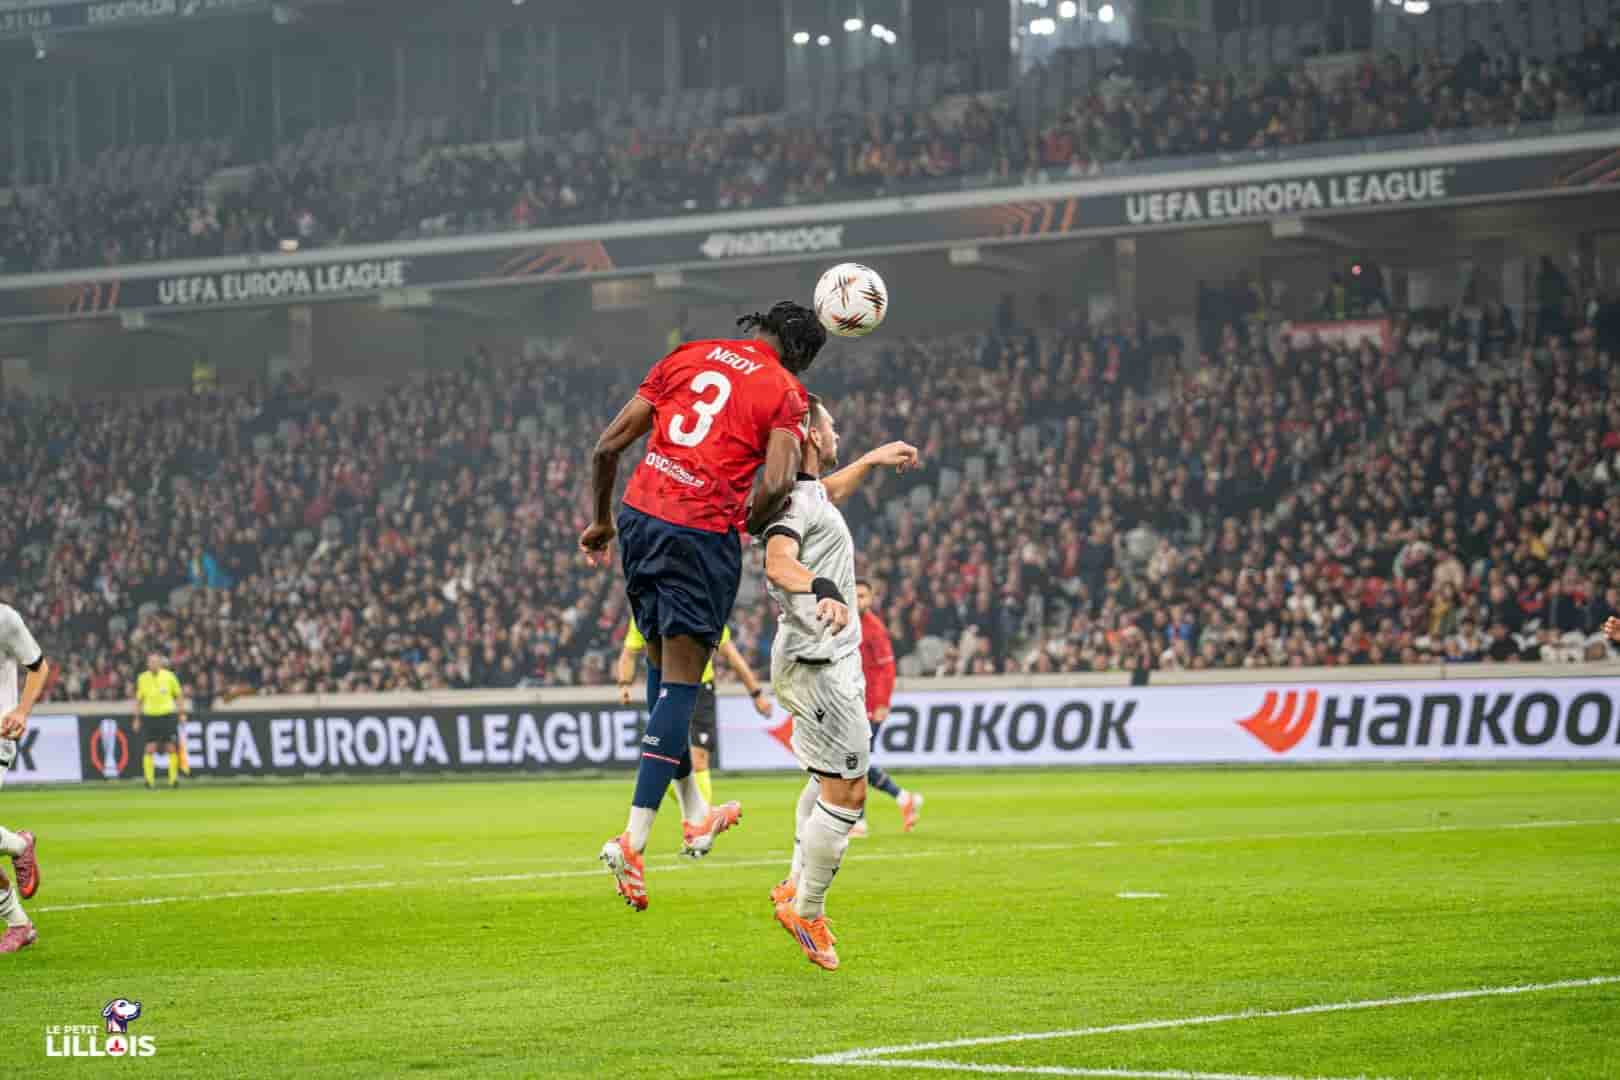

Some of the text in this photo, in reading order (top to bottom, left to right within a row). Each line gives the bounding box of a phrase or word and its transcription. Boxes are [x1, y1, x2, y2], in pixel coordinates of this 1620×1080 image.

[1126, 169, 1446, 223] UEFA EUROPA LEAGUE
[158, 259, 404, 304] UEFA EUROPA LEAGUE
[705, 346, 764, 375] NGOY
[669, 371, 731, 447] 3
[270, 714, 449, 766] EUROPA
[456, 709, 640, 763] LEAGUE
